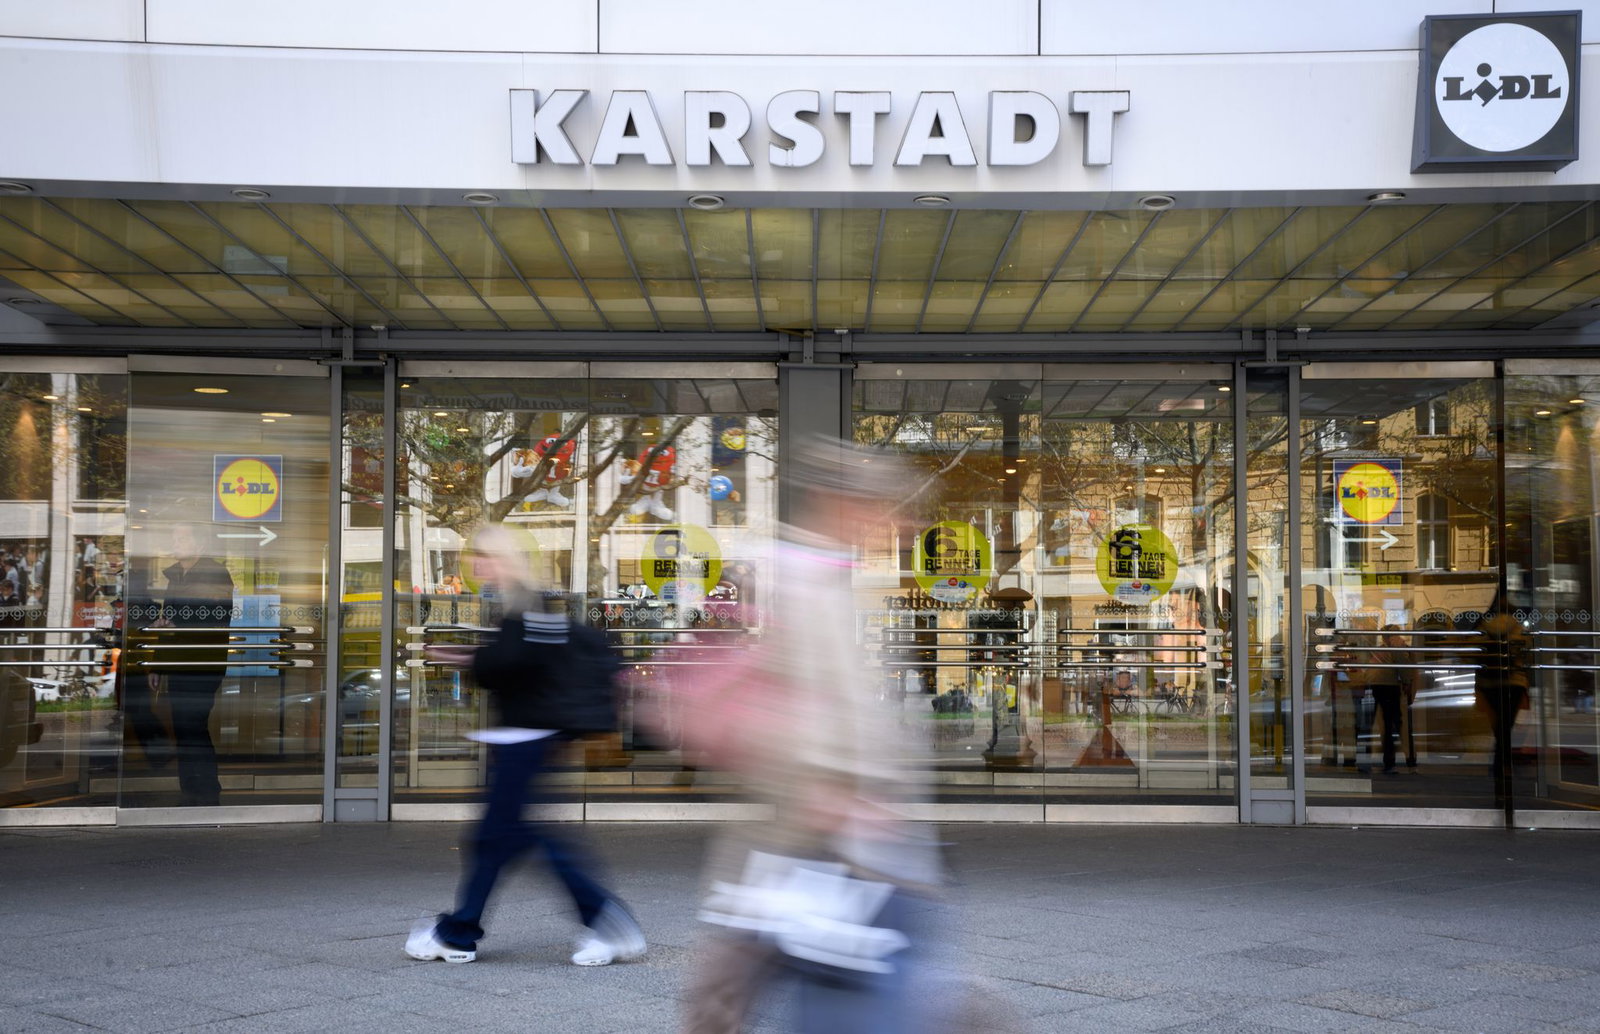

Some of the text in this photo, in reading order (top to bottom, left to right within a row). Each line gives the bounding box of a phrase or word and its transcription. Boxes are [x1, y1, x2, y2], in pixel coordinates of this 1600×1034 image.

[509, 88, 1131, 168] KARSTADT
[654, 529, 687, 558] 6
[924, 527, 957, 557] 6
[1109, 530, 1165, 561] 6 TAGE
